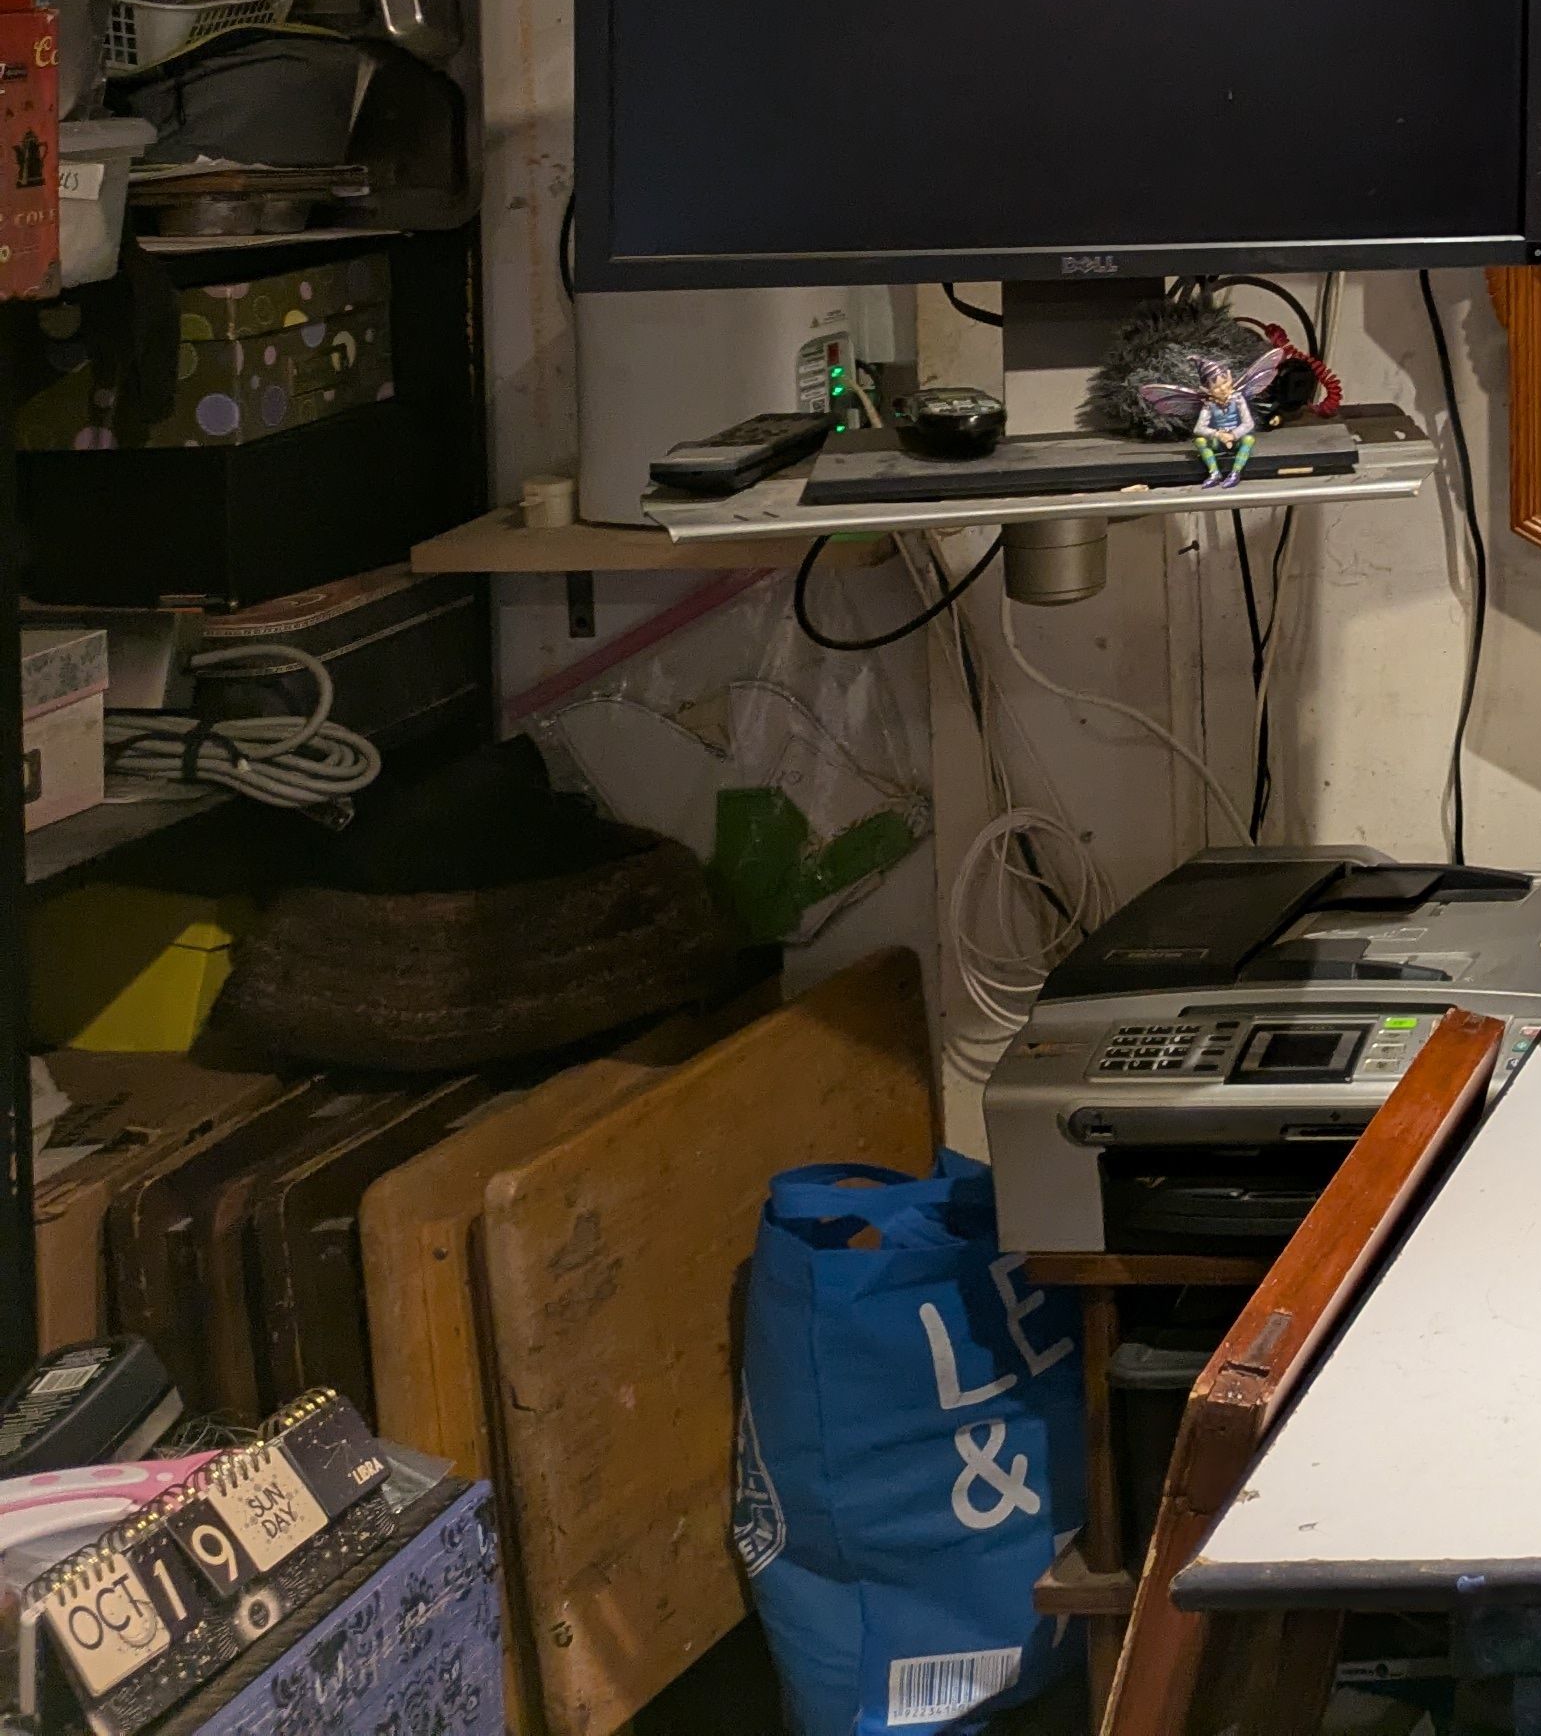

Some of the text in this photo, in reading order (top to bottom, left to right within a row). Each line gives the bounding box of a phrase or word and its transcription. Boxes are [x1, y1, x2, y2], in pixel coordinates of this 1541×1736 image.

[1062, 256, 1118, 273] DELL
[352, 1457, 384, 1485] LIBRA
[952, 1419, 1040, 1528] &
[249, 1483, 286, 1518] SUN
[262, 1502, 299, 1539] DAY
[69, 1575, 144, 1650] OCT
